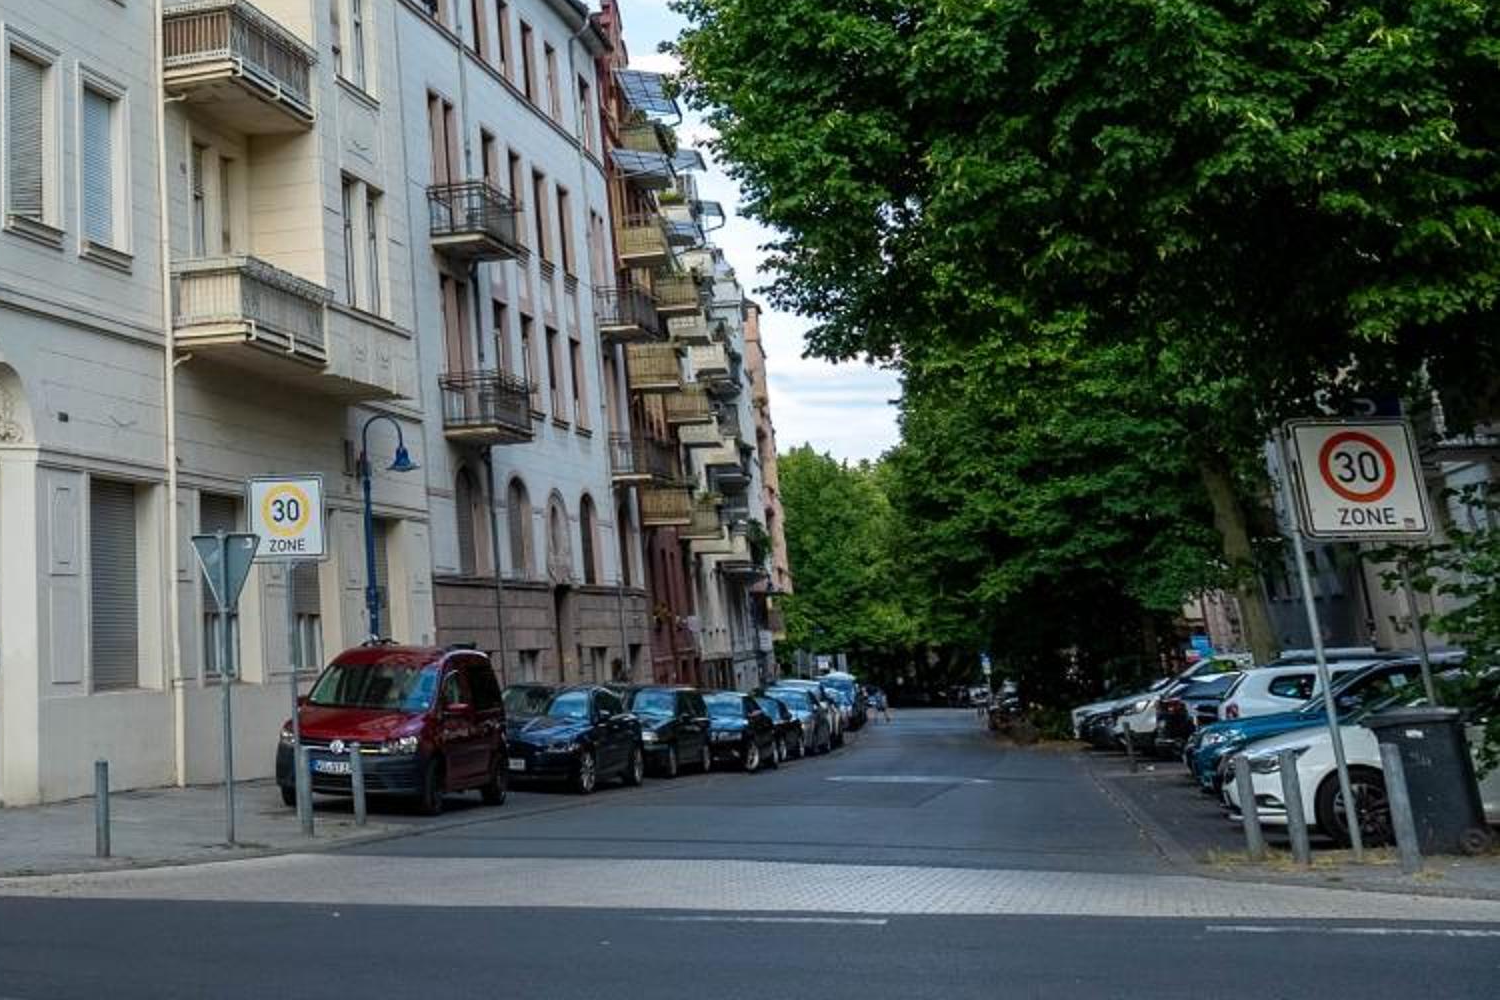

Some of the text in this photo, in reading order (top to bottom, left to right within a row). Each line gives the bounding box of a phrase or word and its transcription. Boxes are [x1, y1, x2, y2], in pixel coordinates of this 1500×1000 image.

[1334, 451, 1380, 483] 30
[272, 499, 299, 522] 30
[1338, 507, 1397, 526] ZONE
[268, 538, 306, 553] ZONE
